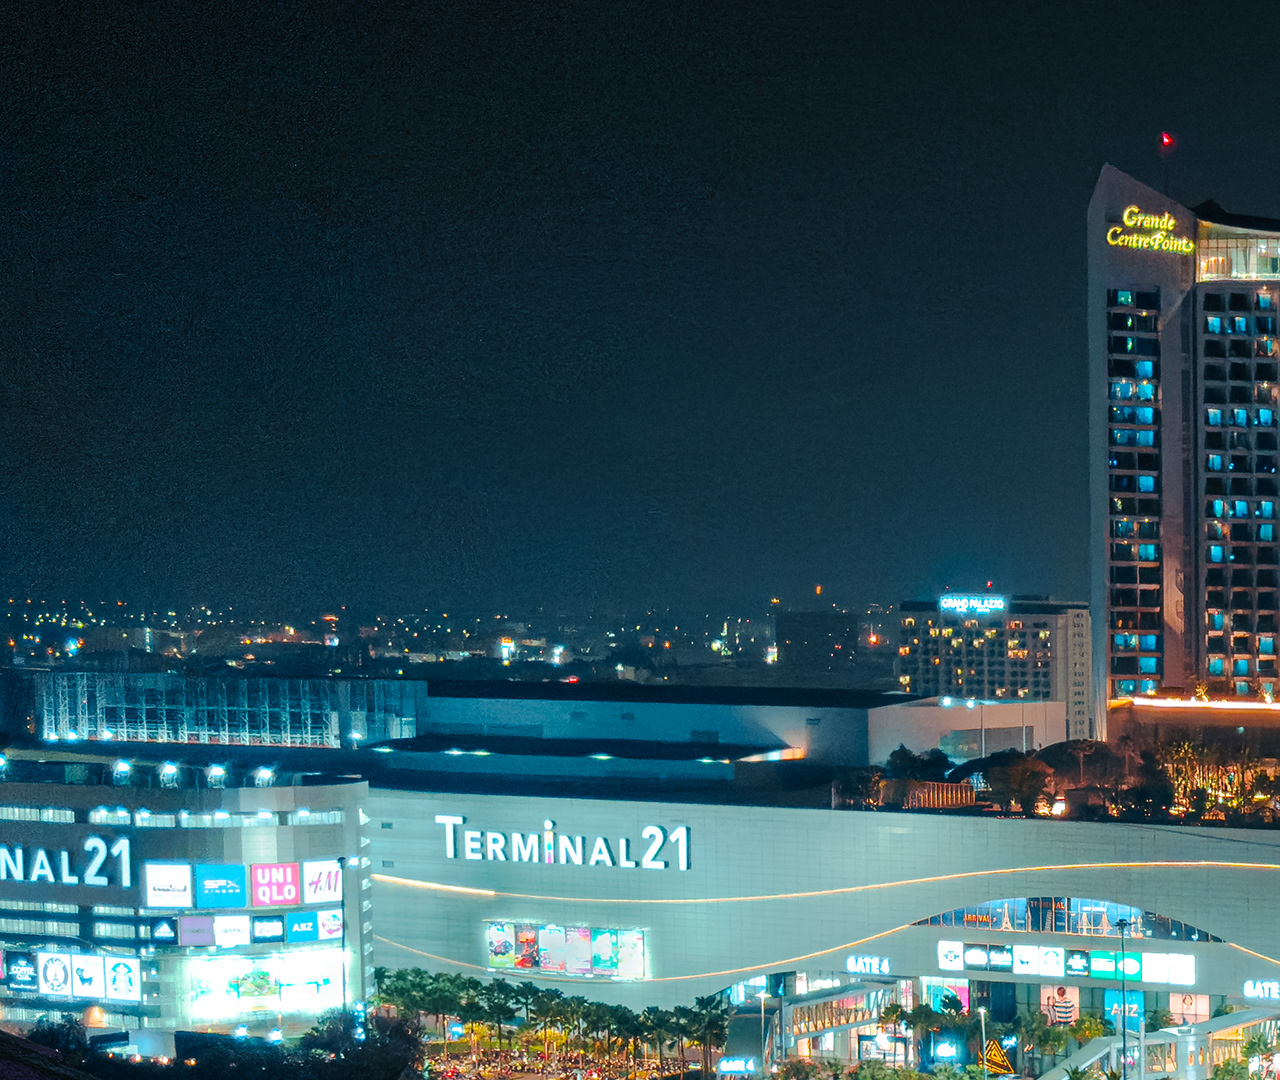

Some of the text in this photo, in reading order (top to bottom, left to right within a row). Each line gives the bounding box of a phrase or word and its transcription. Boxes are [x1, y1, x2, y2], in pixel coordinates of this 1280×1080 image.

[1122, 204, 1176, 231] Grande
[308, 870, 340, 894] H&M
[847, 956, 880, 974] GATE
[1244, 980, 1279, 999] GATE
